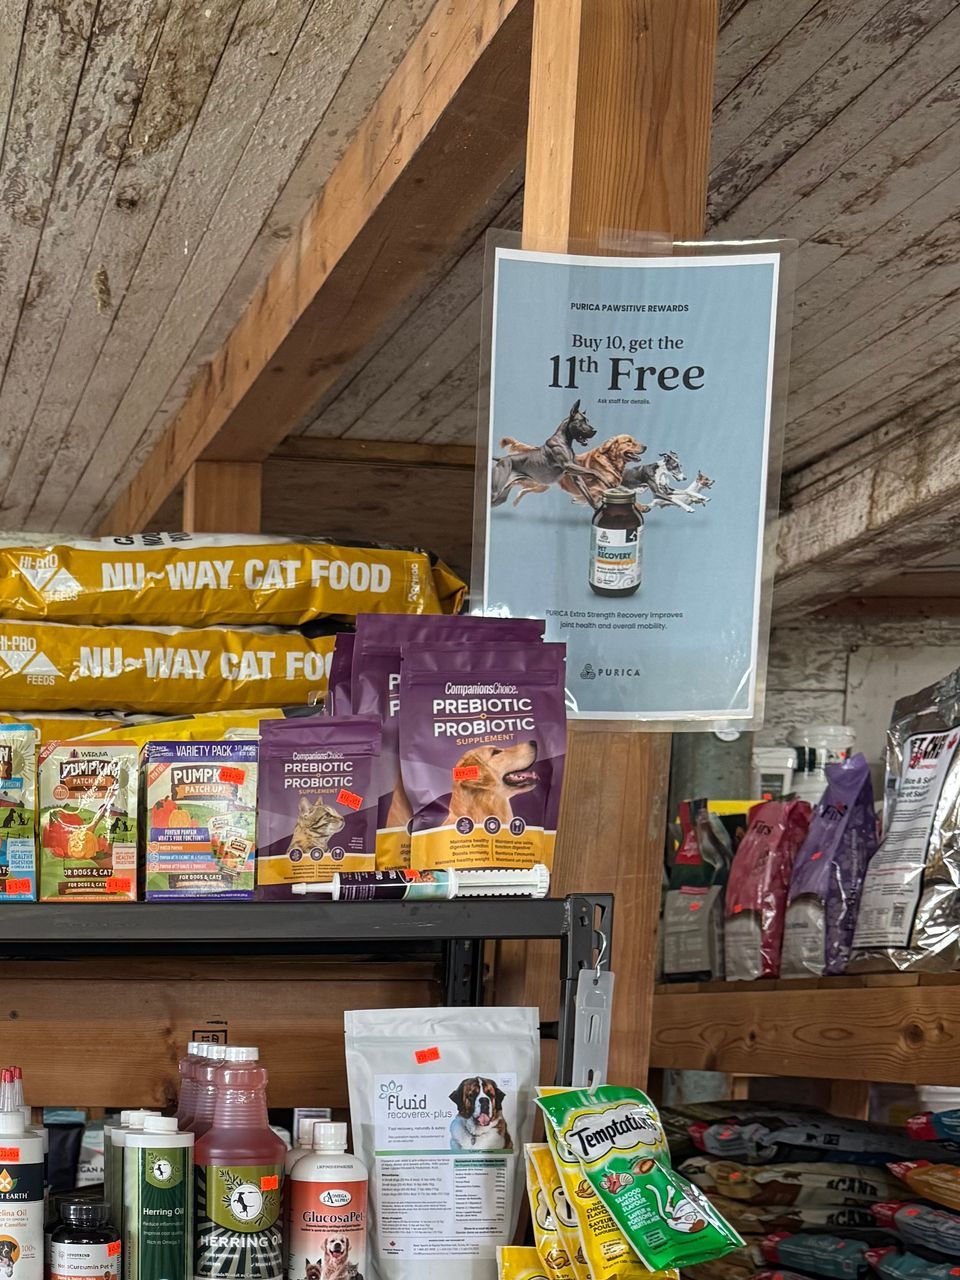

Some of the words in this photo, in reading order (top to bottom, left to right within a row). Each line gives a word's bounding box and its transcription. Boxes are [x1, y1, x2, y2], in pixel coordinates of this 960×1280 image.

[570, 302, 600, 312] PURICA
[601, 304, 646, 312] PAWSITIVE
[647, 304, 689, 312] REWARDS
[572, 334, 602, 352] Buy
[606, 336, 626, 351] 10,
[628, 337, 653, 353] get
[658, 336, 684, 349] the
[548, 355, 599, 389] 11th
[608, 357, 705, 391] Free
[597, 552, 632, 560] RECOVERY
[243, 559, 300, 588] CAT
[308, 560, 391, 593] FOOD
[545, 609, 569, 618] PURICA
[570, 610, 586, 618] Extra
[587, 610, 616, 620] Strength
[617, 611, 648, 621] Recovery
[560, 621, 575, 630] joint
[575, 621, 597, 629] health
[637, 622, 667, 631] mobility.
[220, 651, 276, 681] CAT
[598, 669, 640, 677] PURICA
[26, 674, 55, 687] FEEDS
[433, 698, 532, 714] PREBIOTIC
[433, 717, 536, 737] PROBIOTIC
[455, 733, 515, 746] SUPPLEMENT
[175, 745, 209, 757] VARIETY
[211, 745, 233, 757] PACK
[284, 761, 353, 774] PREBIOTIC
[284, 776, 353, 789] PROBIOTIC
[298, 788, 339, 796] SUPPLEMENT
[388, 1094, 427, 1110] fluid
[387, 1109, 453, 1120] recoverex-plus
[6, 1192, 28, 1200] EARTH
[16, 1208, 27, 1217] Oil
[200, 1235, 269, 1249] HERRING
